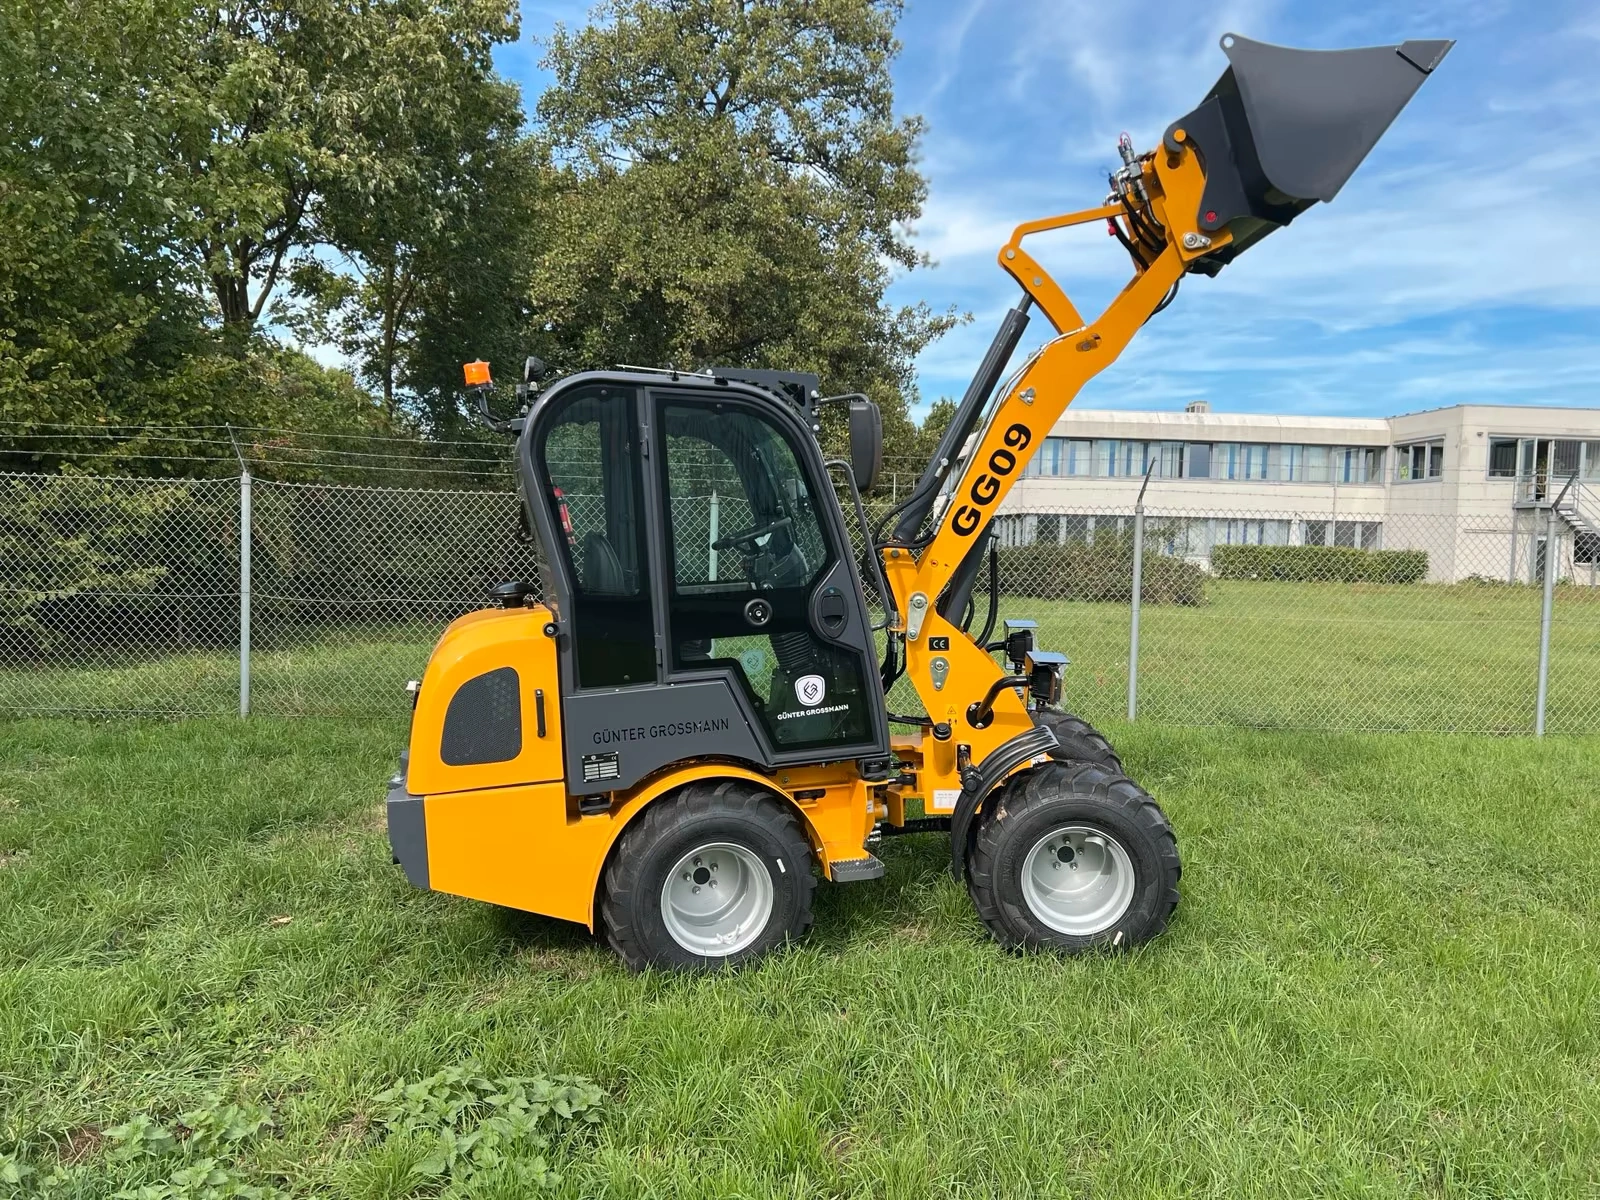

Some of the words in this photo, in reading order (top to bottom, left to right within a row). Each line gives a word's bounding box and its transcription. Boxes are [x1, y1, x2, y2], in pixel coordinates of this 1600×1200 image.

[952, 423, 1031, 536] GG09
[932, 639, 946, 649] CE
[777, 710, 805, 720] GÜNTER
[806, 704, 849, 715] GROSSMANN
[593, 727, 646, 745] GÜNTER
[650, 718, 729, 738] GROSSMANN
